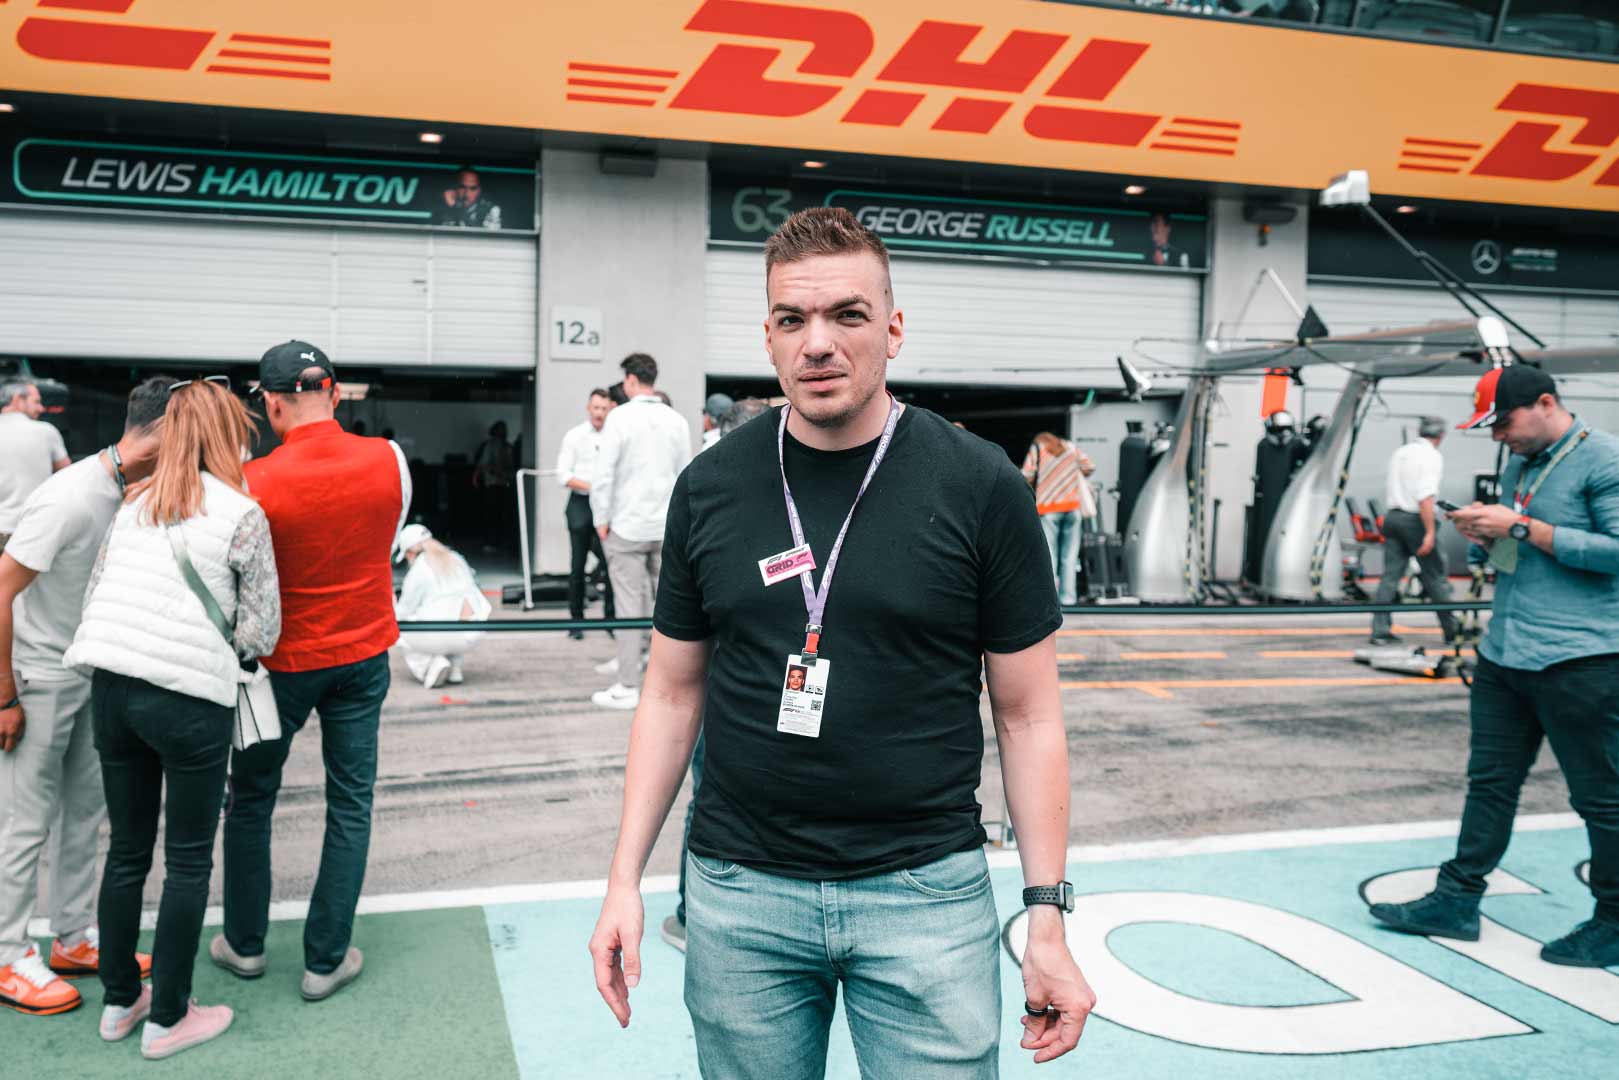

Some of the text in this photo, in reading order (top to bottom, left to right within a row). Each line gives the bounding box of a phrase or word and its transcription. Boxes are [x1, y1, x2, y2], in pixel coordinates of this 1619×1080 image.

[667, 0, 1164, 147] DHL
[61, 157, 419, 205] LEWIS HAMILTON
[732, 186, 792, 234] 63
[857, 205, 1115, 247] GEORGE RUSSELL
[555, 320, 600, 346] 12a
